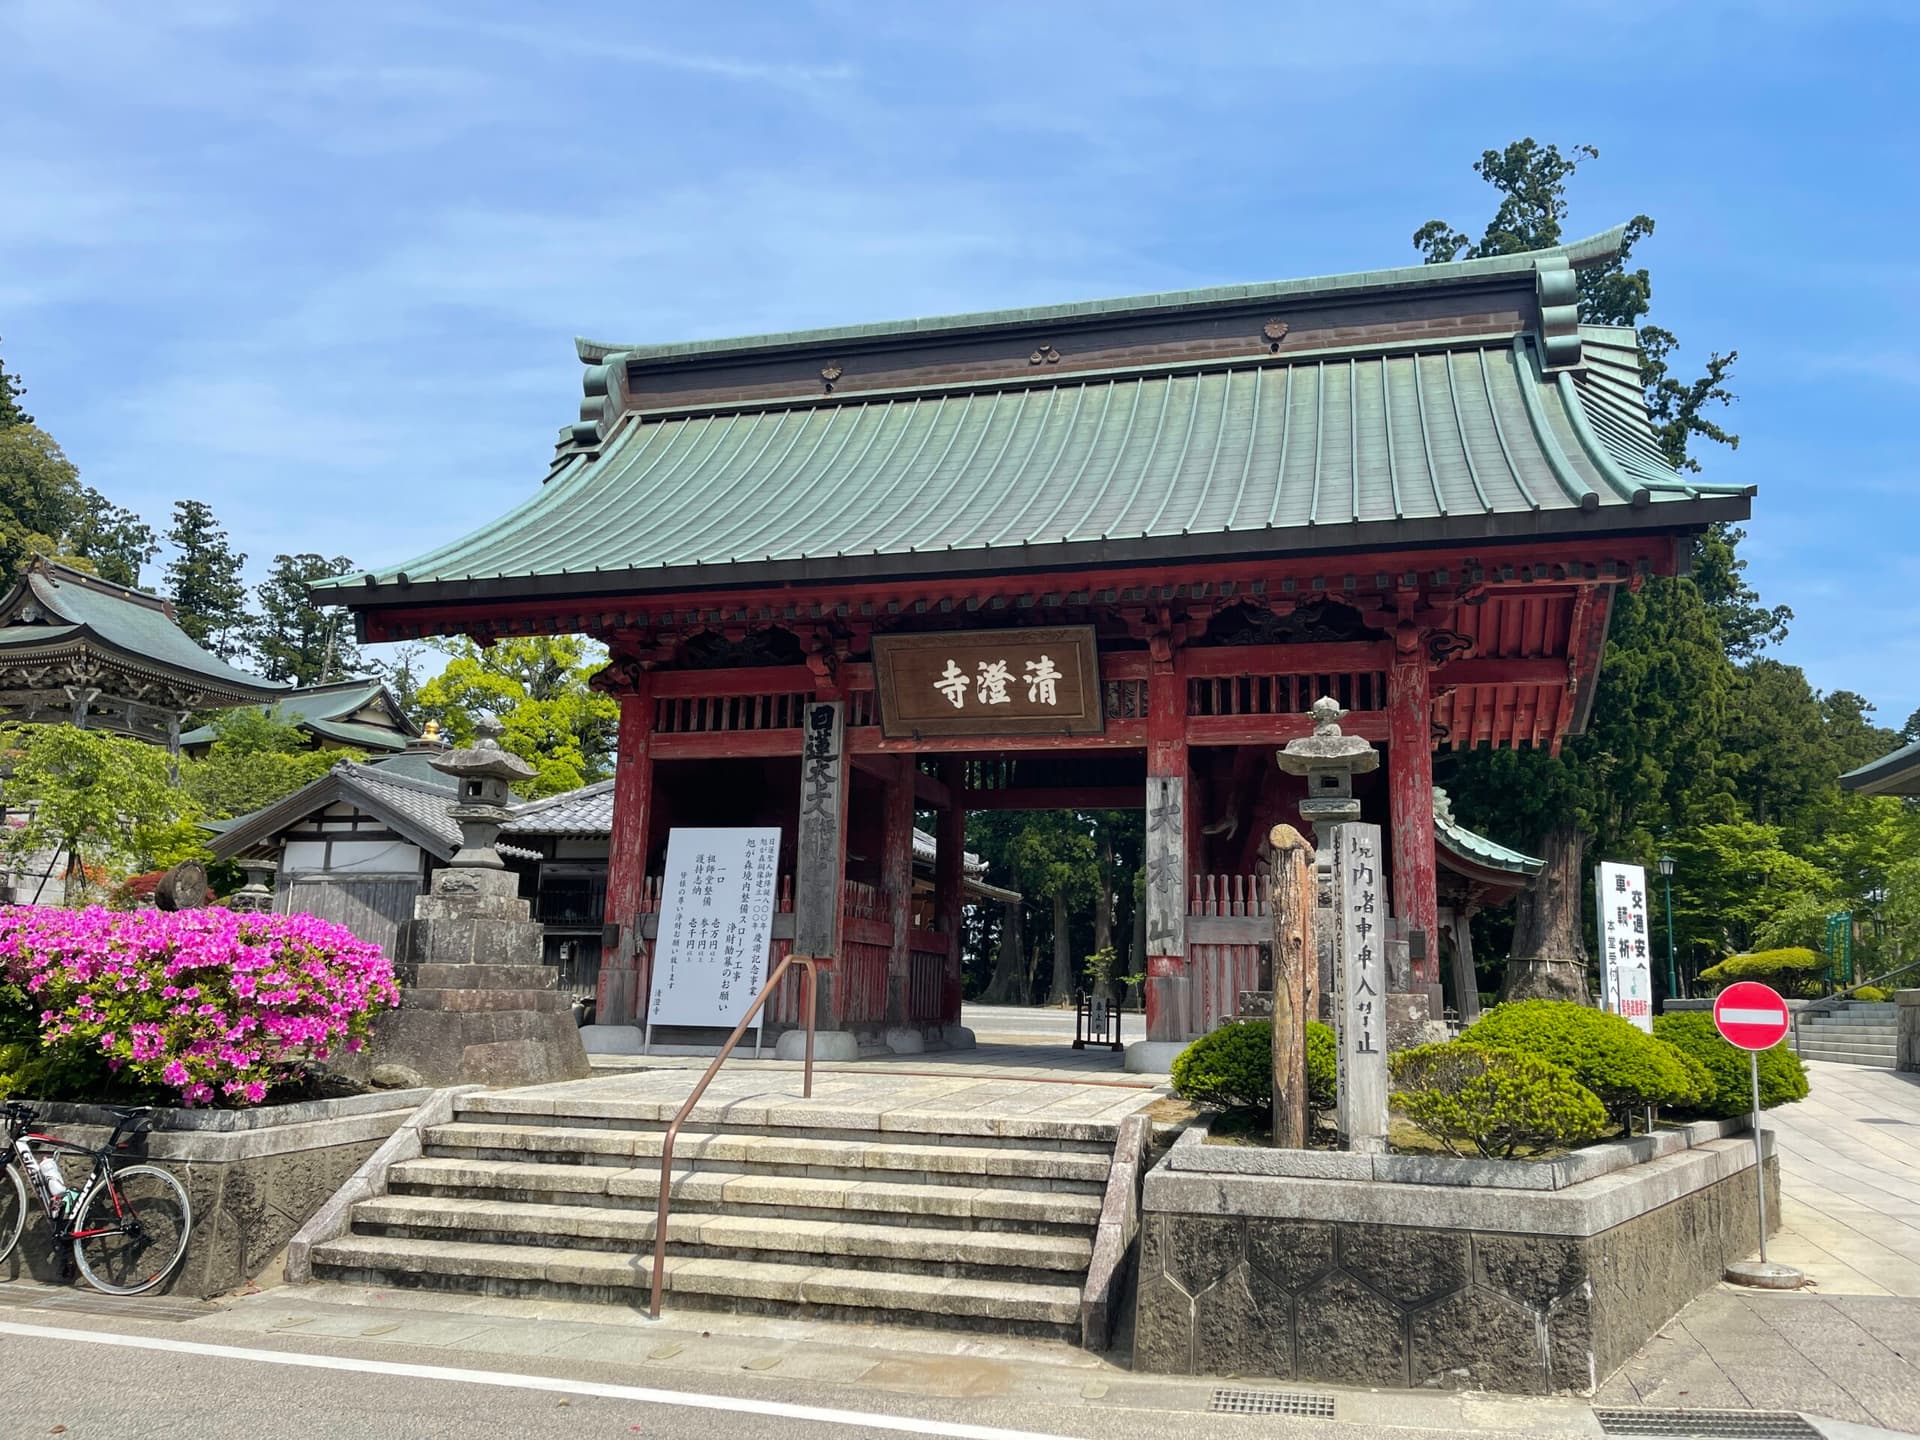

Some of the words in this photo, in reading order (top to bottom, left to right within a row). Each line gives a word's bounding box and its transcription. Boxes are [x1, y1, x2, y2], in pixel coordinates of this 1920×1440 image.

[933, 654, 1063, 709] 清澄寺
[717, 867, 727, 884] 一口
[1147, 786, 1182, 943] 大本山
[1631, 889, 1647, 970] 交通安
